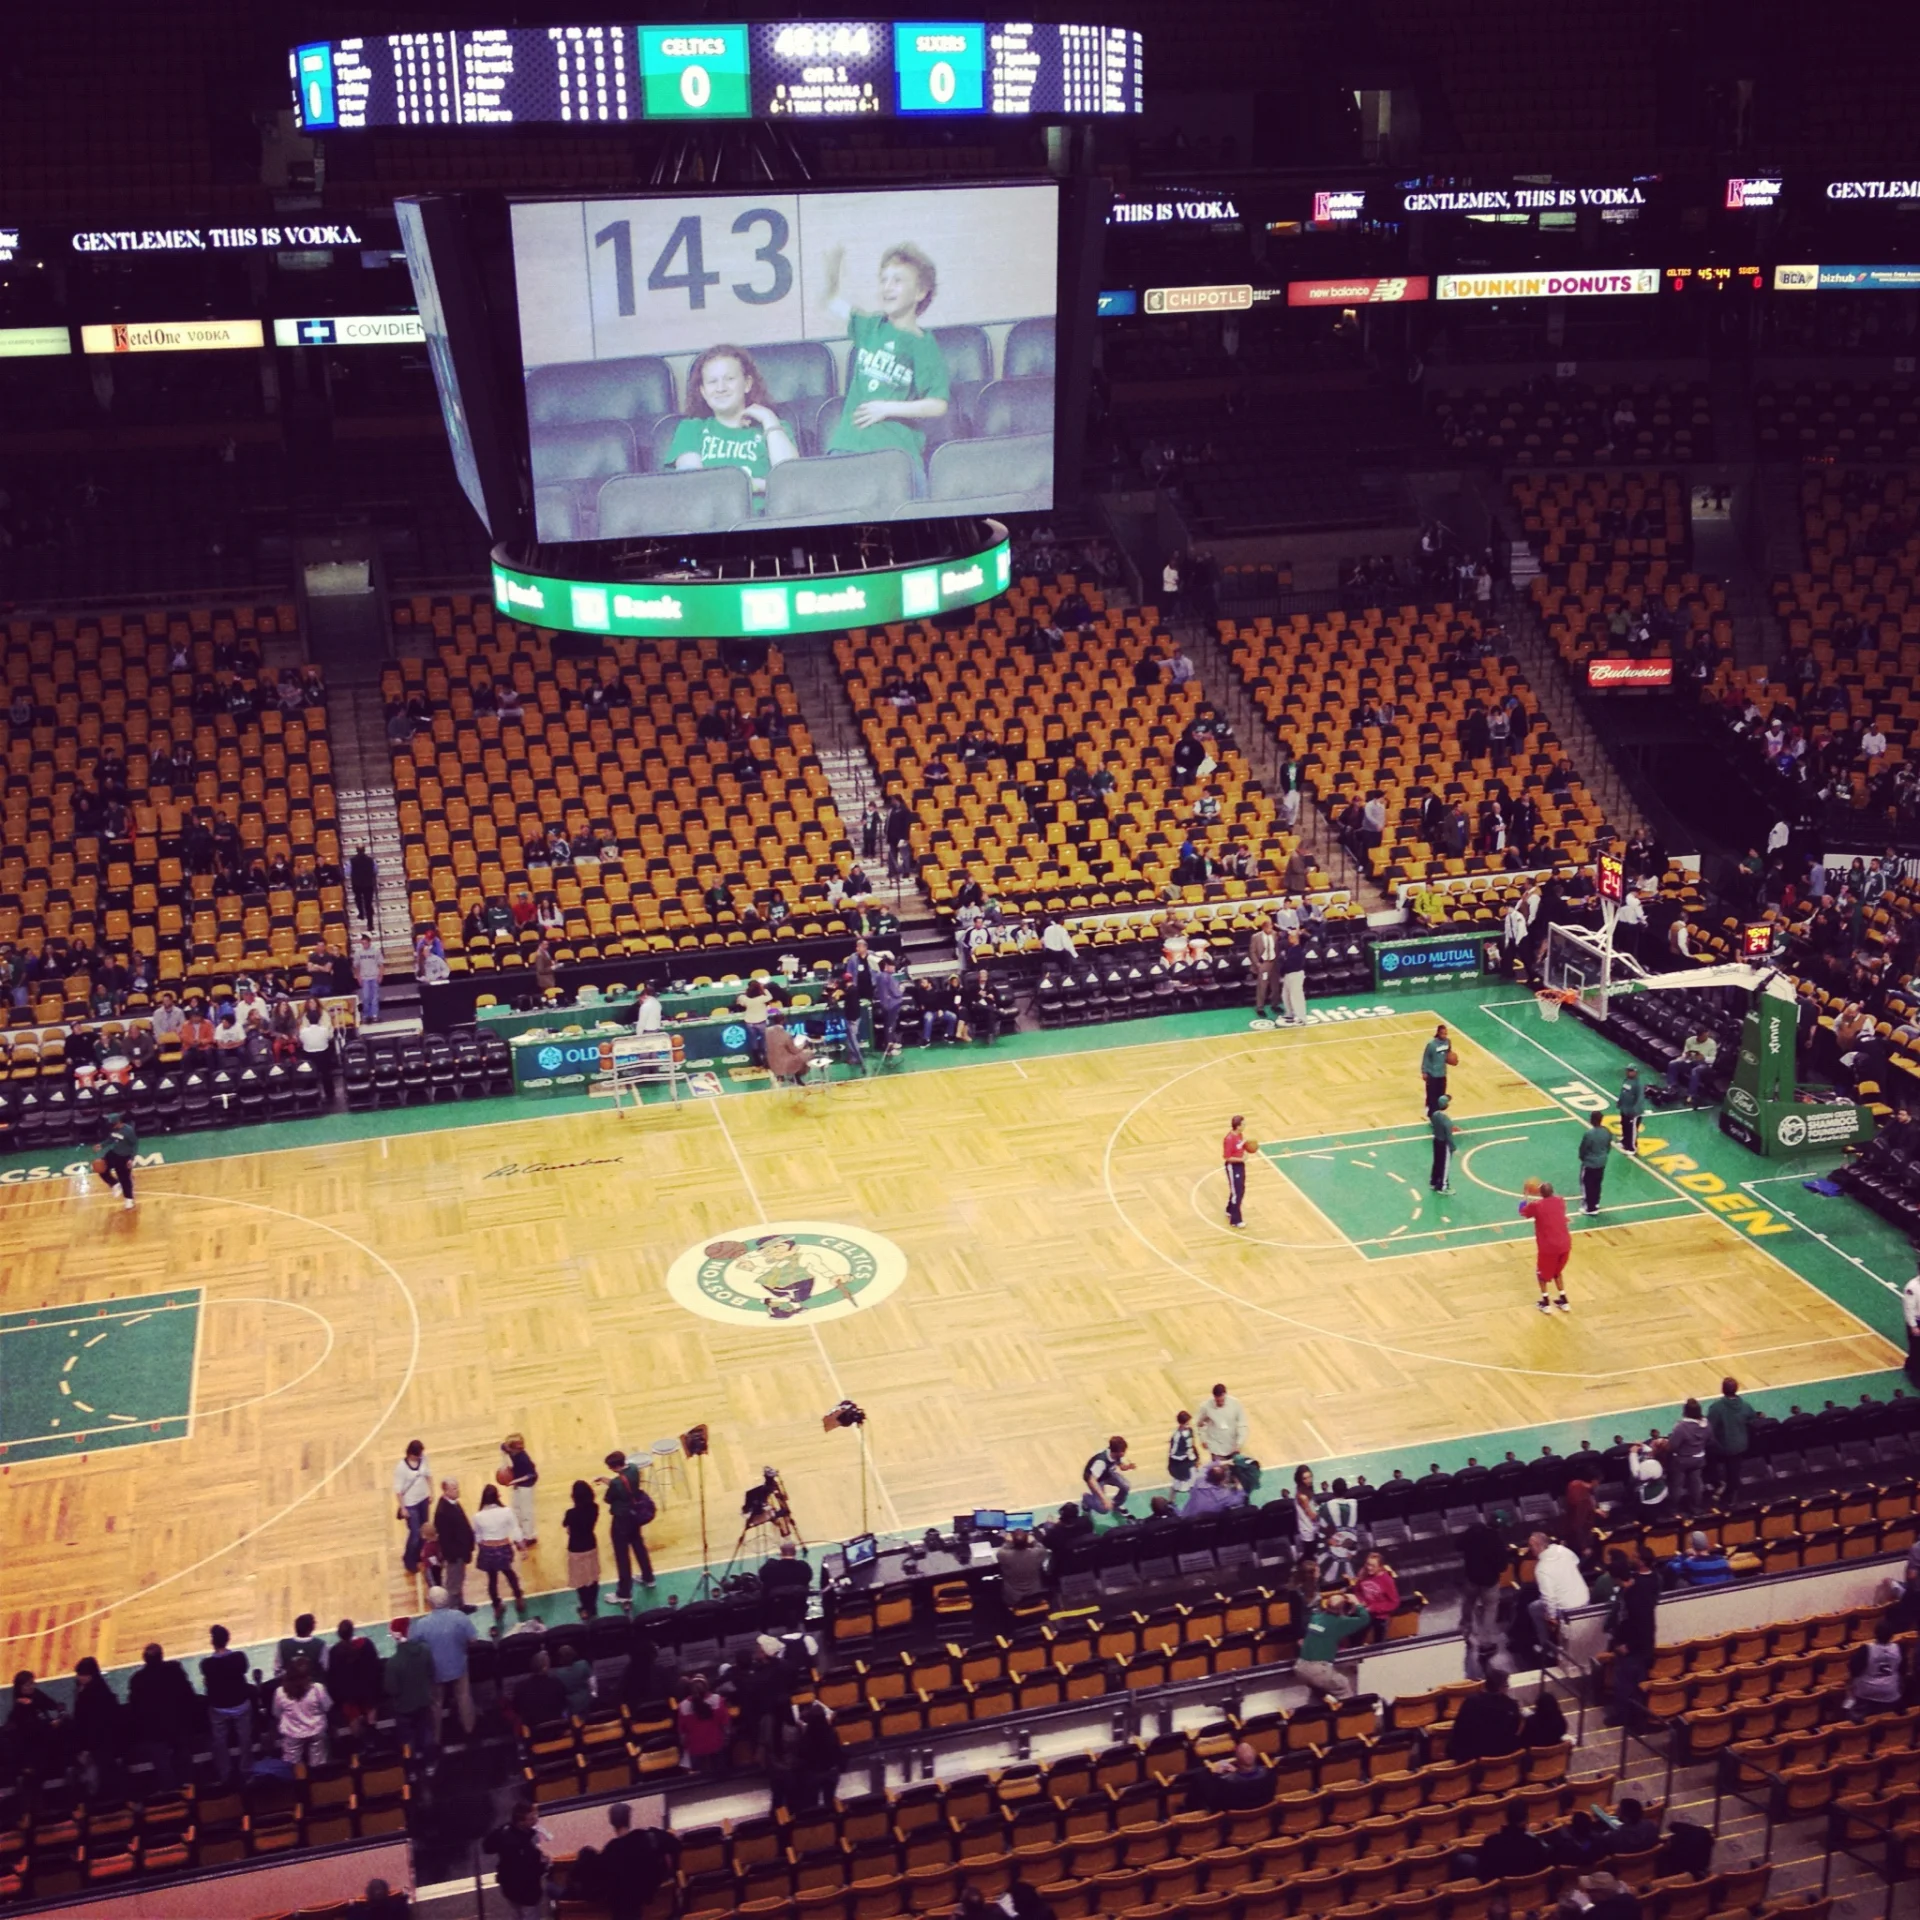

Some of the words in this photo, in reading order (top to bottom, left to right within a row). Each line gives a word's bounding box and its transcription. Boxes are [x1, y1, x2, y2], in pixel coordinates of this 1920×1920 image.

[661, 38, 726, 56] CELTICS
[680, 64, 711, 109] 0
[929, 61, 956, 104] 0
[1514, 189, 1556, 207] THIS
[1559, 189, 1577, 206] IS
[1113, 204, 1154, 222] THIS
[1156, 203, 1173, 221] IS
[209, 227, 258, 248] THIS
[261, 226, 282, 246] IS
[595, 208, 793, 317] 143
[1666, 268, 1692, 277] CELTICS
[1458, 278, 1546, 297] DUNKIN'
[1548, 275, 1632, 294] DONUTS
[1782, 273, 1806, 285] BCA
[1820, 273, 1857, 283] bizhub
[1169, 291, 1247, 307] CHIPOTLE
[1309, 289, 1330, 299] new
[1330, 286, 1370, 298] balance
[188, 330, 231, 344] VODKA
[701, 435, 758, 462] CELTICS
[941, 563, 984, 595] Bank
[613, 594, 683, 618] Bank
[795, 585, 866, 615] Bank
[1588, 664, 1672, 681] Budweiser
[1603, 869, 1620, 897] 24
[1750, 937, 1767, 951] 24
[1401, 953, 1427, 967] OLD
[1428, 948, 1476, 963] MUTUAL
[1550, 1080, 1611, 1111] TD
[819, 1236, 874, 1280] CELTICS
[701, 1260, 749, 1307] BOSTON
